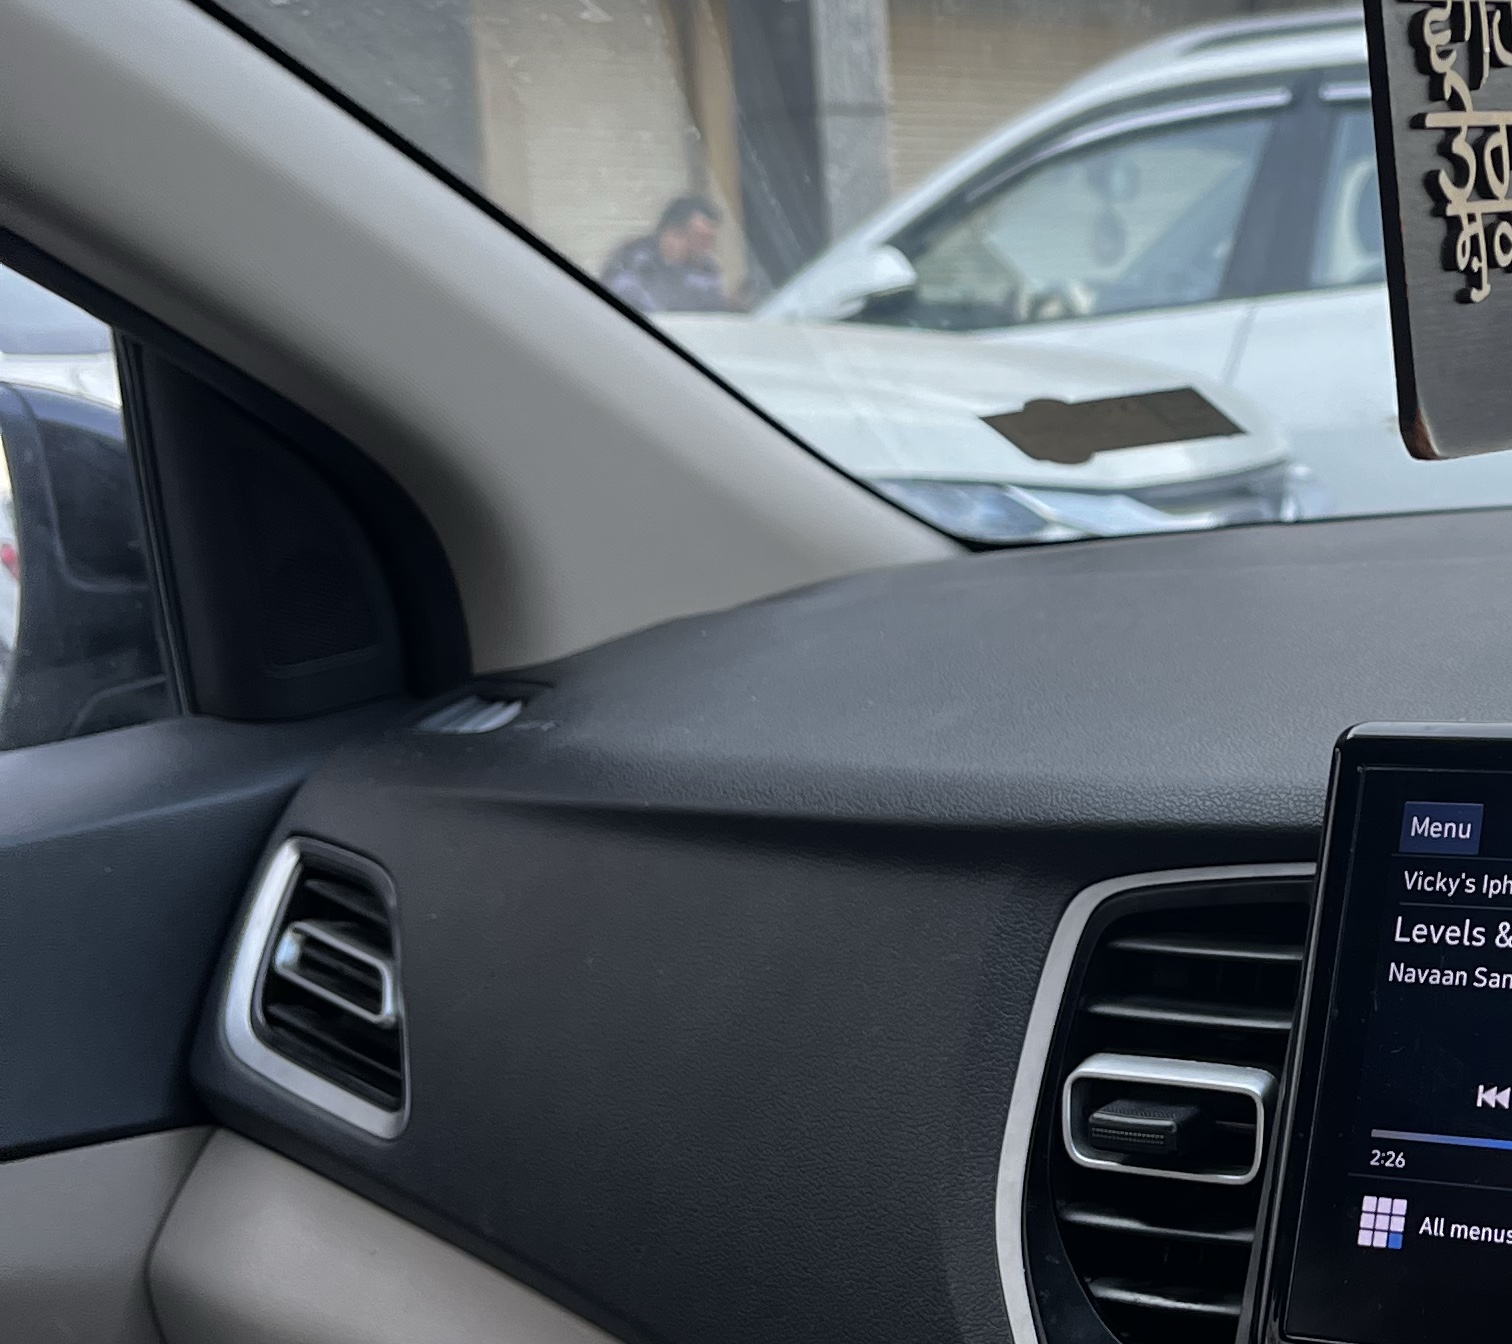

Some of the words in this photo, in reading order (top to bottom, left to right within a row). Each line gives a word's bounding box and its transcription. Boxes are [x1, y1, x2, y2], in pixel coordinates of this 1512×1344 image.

[1410, 815, 1472, 841] Menu
[1403, 871, 1476, 898] Vicky's
[1394, 916, 1486, 948] Levels
[1388, 962, 1467, 987] Navaan
[1370, 1149, 1406, 1170] 2:26
[1418, 1216, 1447, 1240] All
